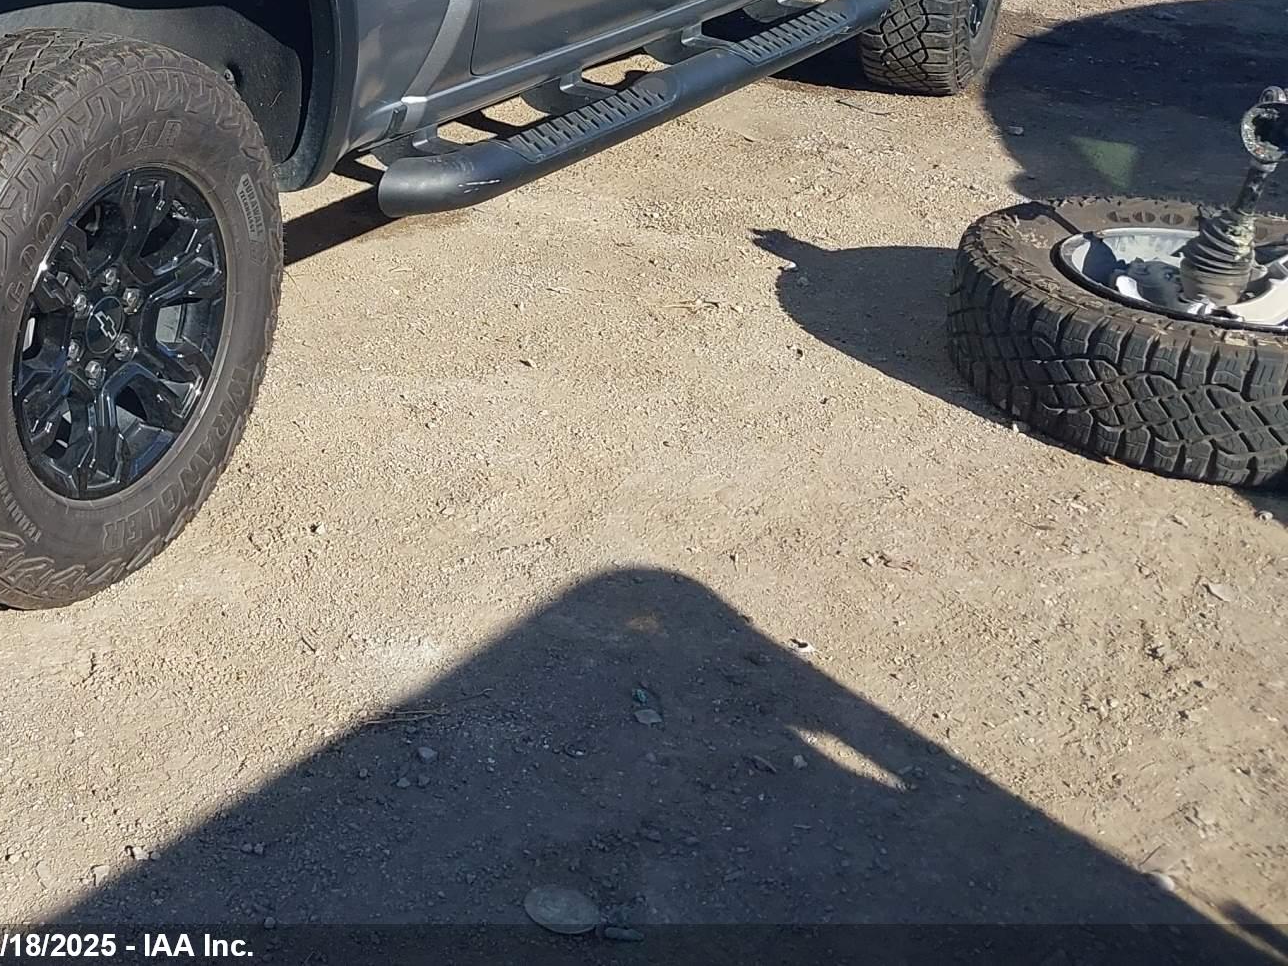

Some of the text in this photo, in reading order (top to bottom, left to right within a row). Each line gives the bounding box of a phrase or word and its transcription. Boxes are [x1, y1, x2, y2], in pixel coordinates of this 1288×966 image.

[6, 119, 183, 313] GOODYEAR
[242, 177, 265, 237] DURAWALL
[102, 366, 252, 554] WRANGLER
